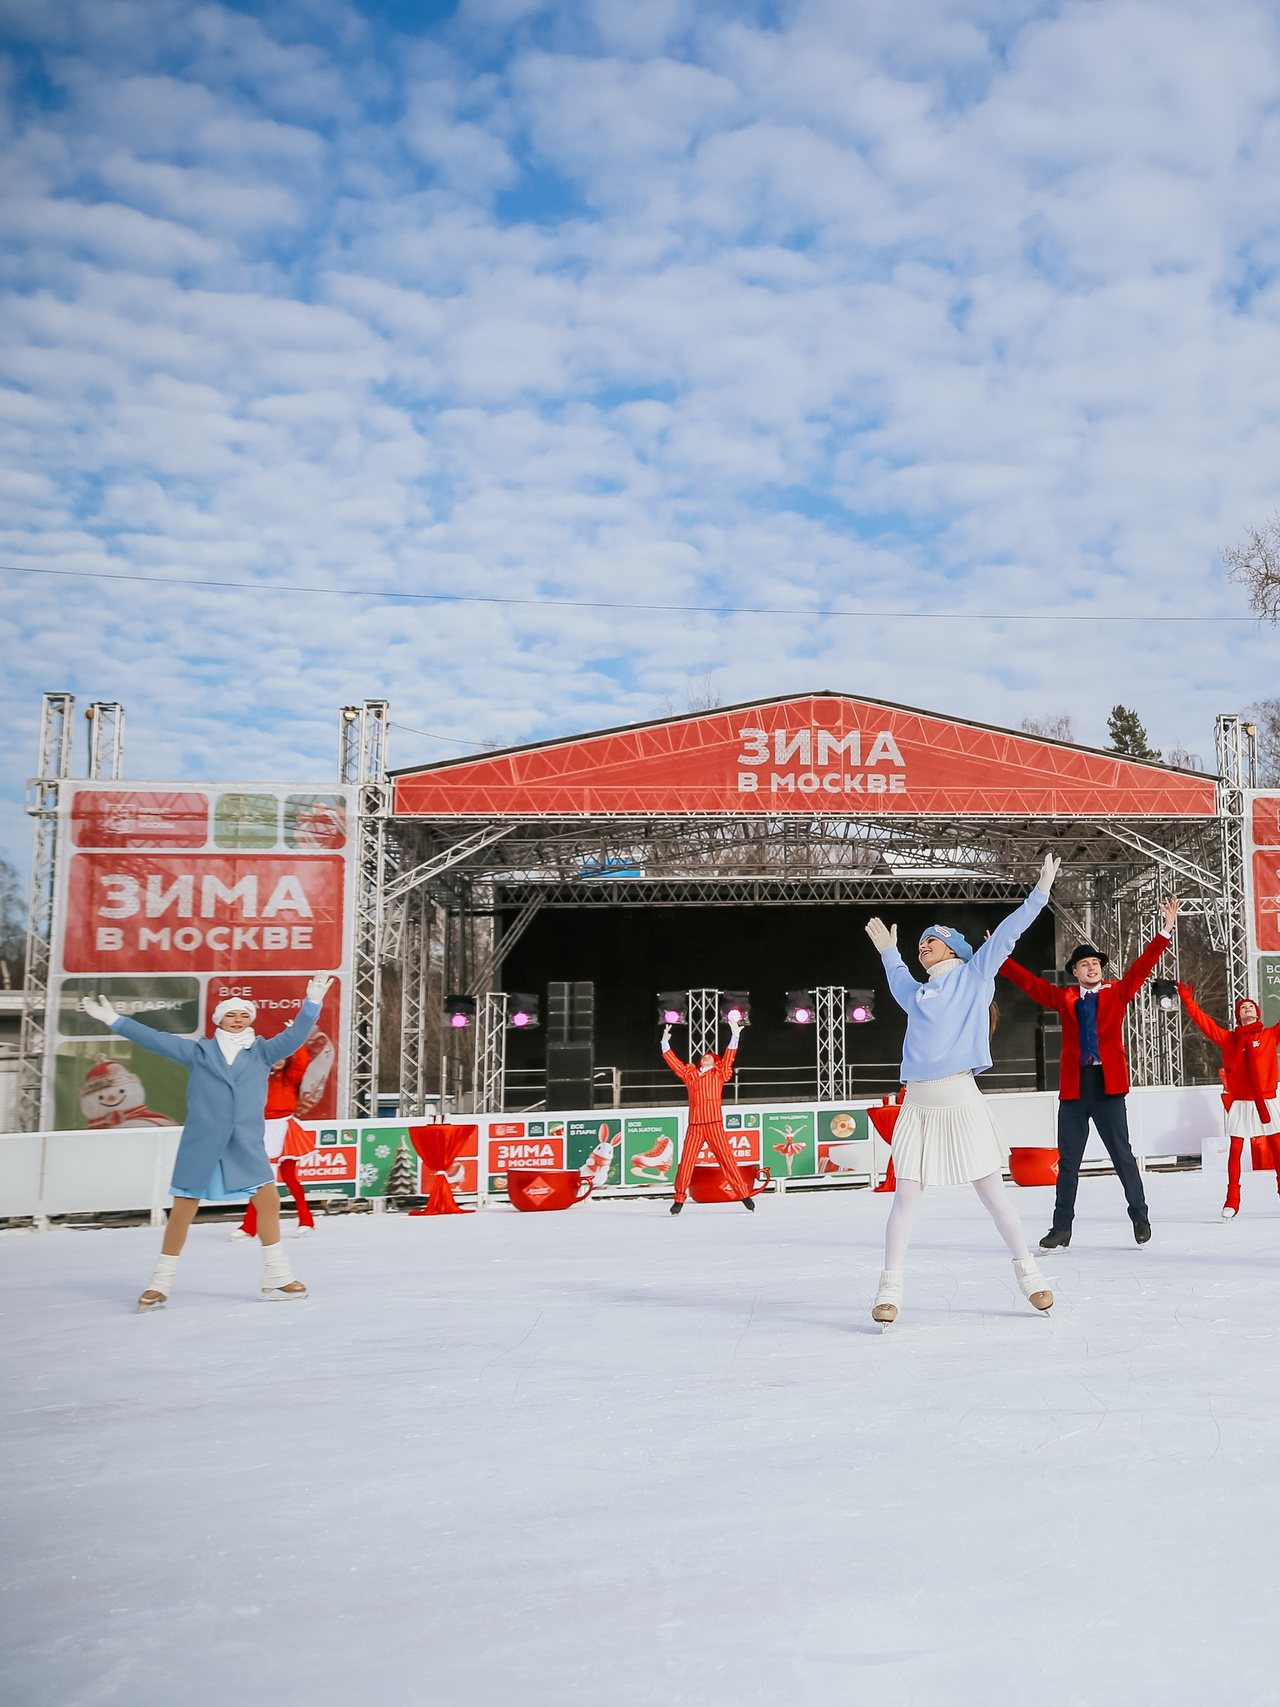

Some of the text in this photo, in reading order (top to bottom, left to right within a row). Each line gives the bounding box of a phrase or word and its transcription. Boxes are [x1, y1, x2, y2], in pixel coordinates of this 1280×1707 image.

[737, 727, 906, 767] ЗИМА
[737, 772, 907, 794] В МОСКВЕ
[98, 874, 314, 919] ЗИМА
[96, 926, 314, 951] В МОСКВЕ
[218, 986, 252, 997] ВСЕ
[116, 1000, 183, 1012] В ПАРК!
[497, 1144, 555, 1159] ЗИМА
[296, 1152, 347, 1167] ИМА
[497, 1158, 555, 1168] В МОСКВЕ
[297, 1167, 347, 1178] МОСКВЕ
